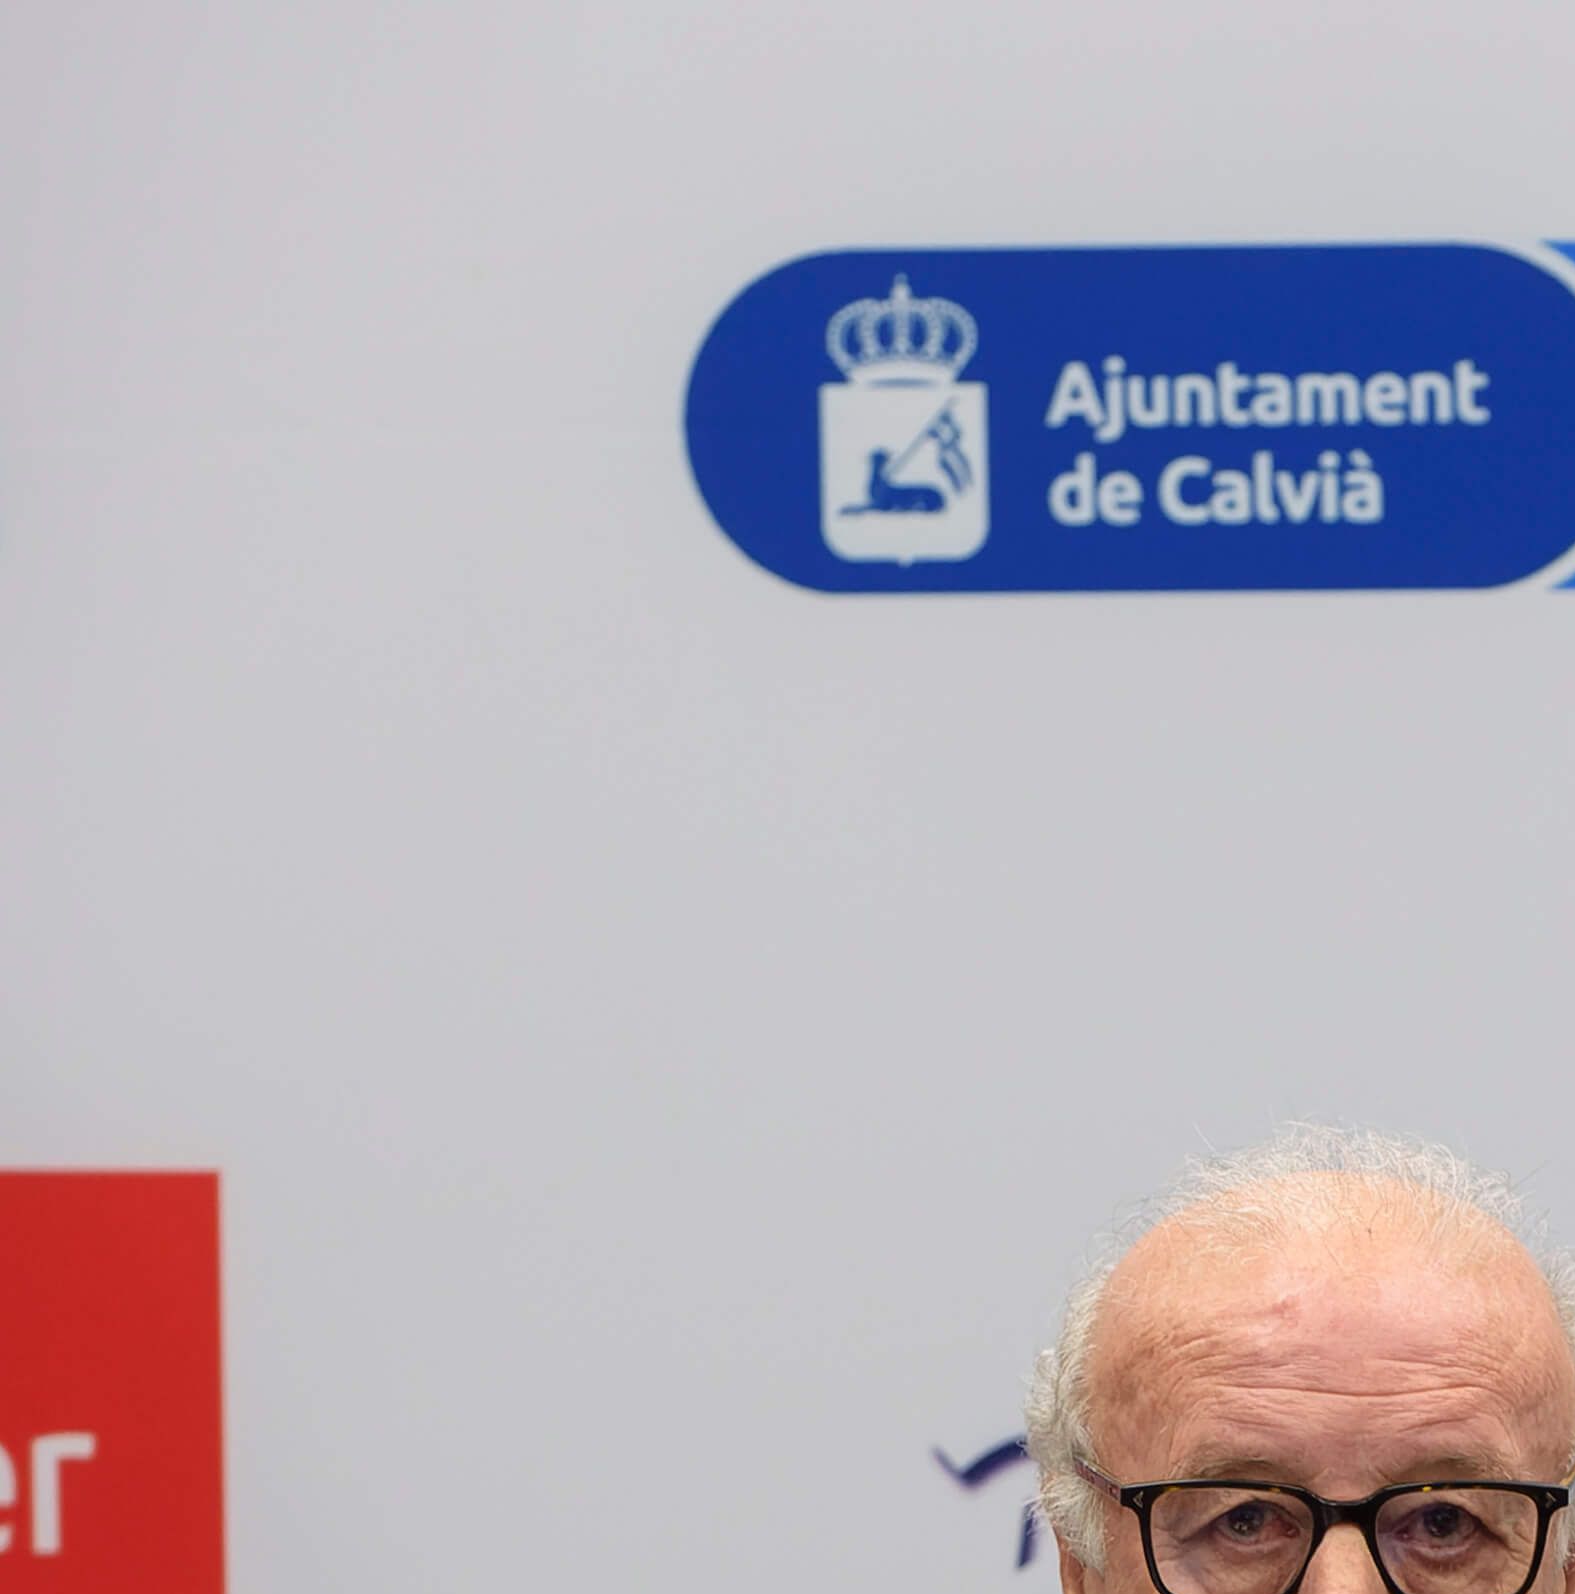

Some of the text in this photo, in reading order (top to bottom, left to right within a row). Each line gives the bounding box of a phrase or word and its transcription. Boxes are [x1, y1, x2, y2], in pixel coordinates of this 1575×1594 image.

[1045, 354, 1492, 444] Ajuntament
[1047, 448, 1386, 528] de Calvià
